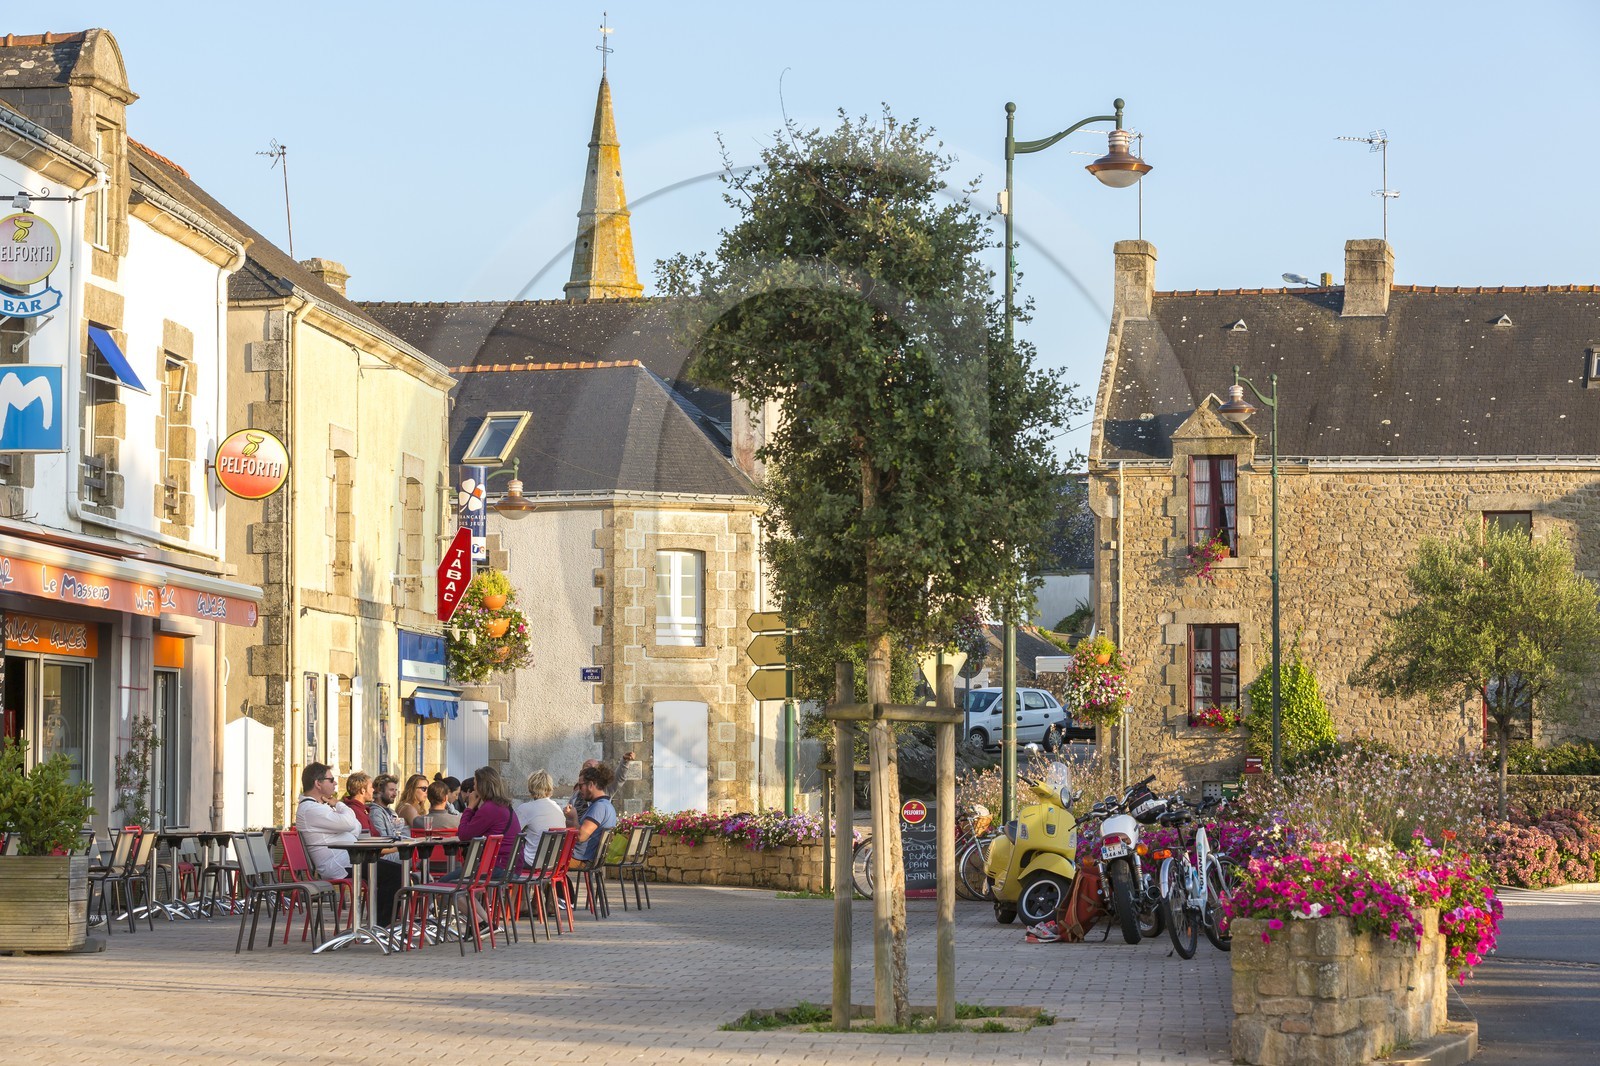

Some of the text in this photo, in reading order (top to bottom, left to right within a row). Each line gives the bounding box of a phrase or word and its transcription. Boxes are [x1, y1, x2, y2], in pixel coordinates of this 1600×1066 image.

[0, 245, 53, 262] ELFORTH
[3, 299, 42, 313] BAR
[220, 456, 282, 478] PELFORTH
[0, 557, 14, 588] AR
[41, 565, 57, 593] Le
[60, 572, 110, 602] Massena
[443, 549, 465, 602] TABAC
